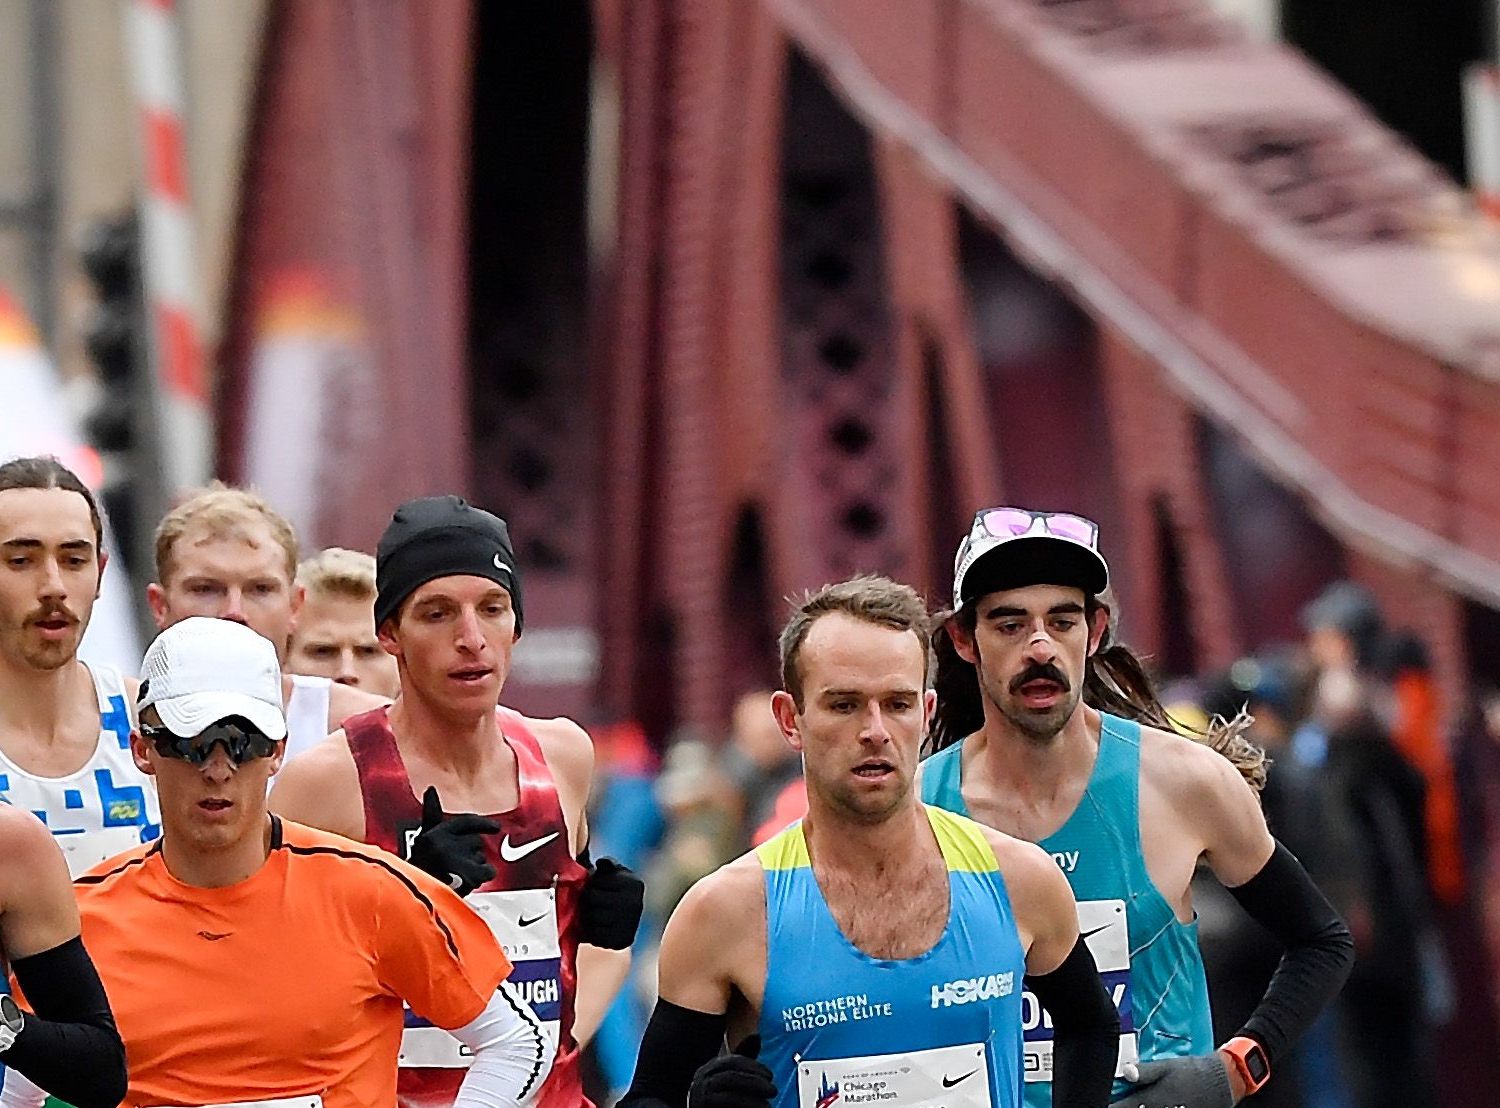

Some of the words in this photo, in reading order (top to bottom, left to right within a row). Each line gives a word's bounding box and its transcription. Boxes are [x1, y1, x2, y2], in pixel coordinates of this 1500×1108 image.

[931, 976, 998, 1008] HOKA
[782, 994, 867, 1020] NORTHERN
[785, 1009, 848, 1032] ARIZONA
[853, 1003, 892, 1020] ELITE
[843, 1081, 886, 1093] Chicago
[844, 1091, 898, 1103] Marathon
